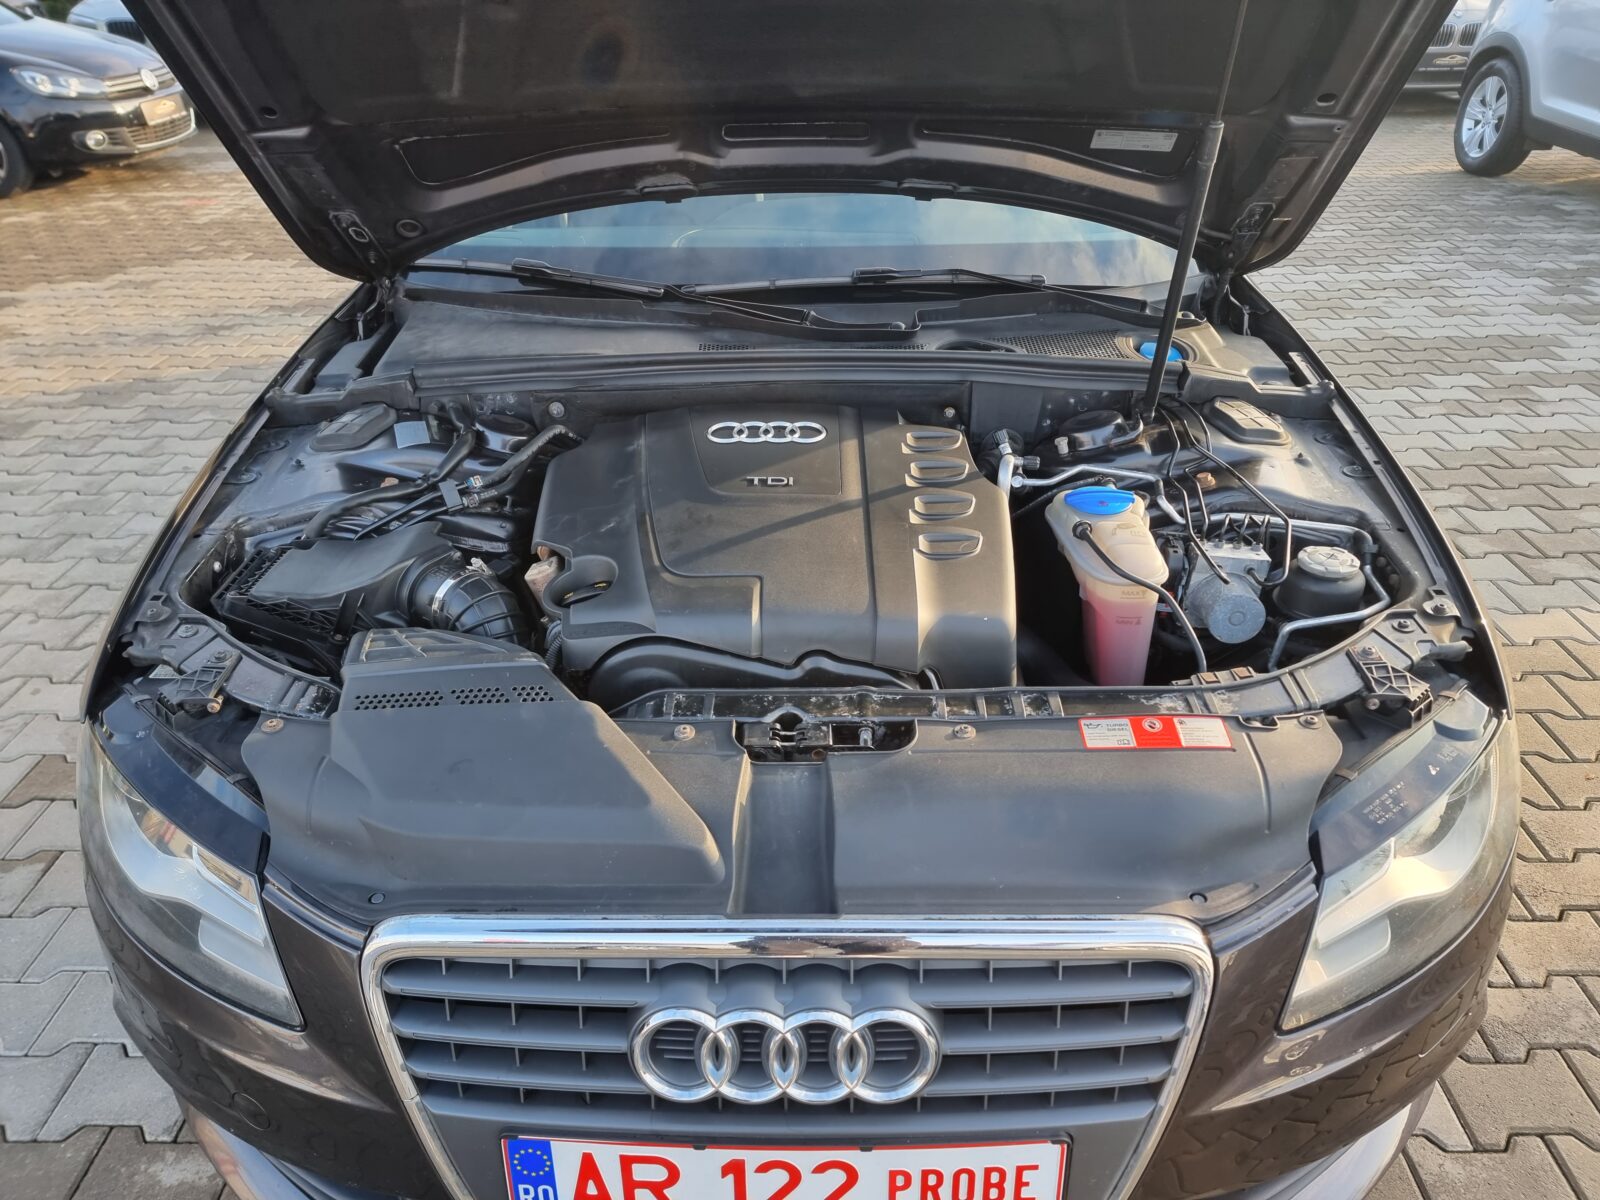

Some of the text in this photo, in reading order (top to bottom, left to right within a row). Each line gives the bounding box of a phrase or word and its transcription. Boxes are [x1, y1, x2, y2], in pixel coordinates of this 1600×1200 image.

[746, 476, 794, 486] TDI
[573, 1152, 1040, 1200] AR 122 PROBE
[518, 1184, 555, 1200] RO
